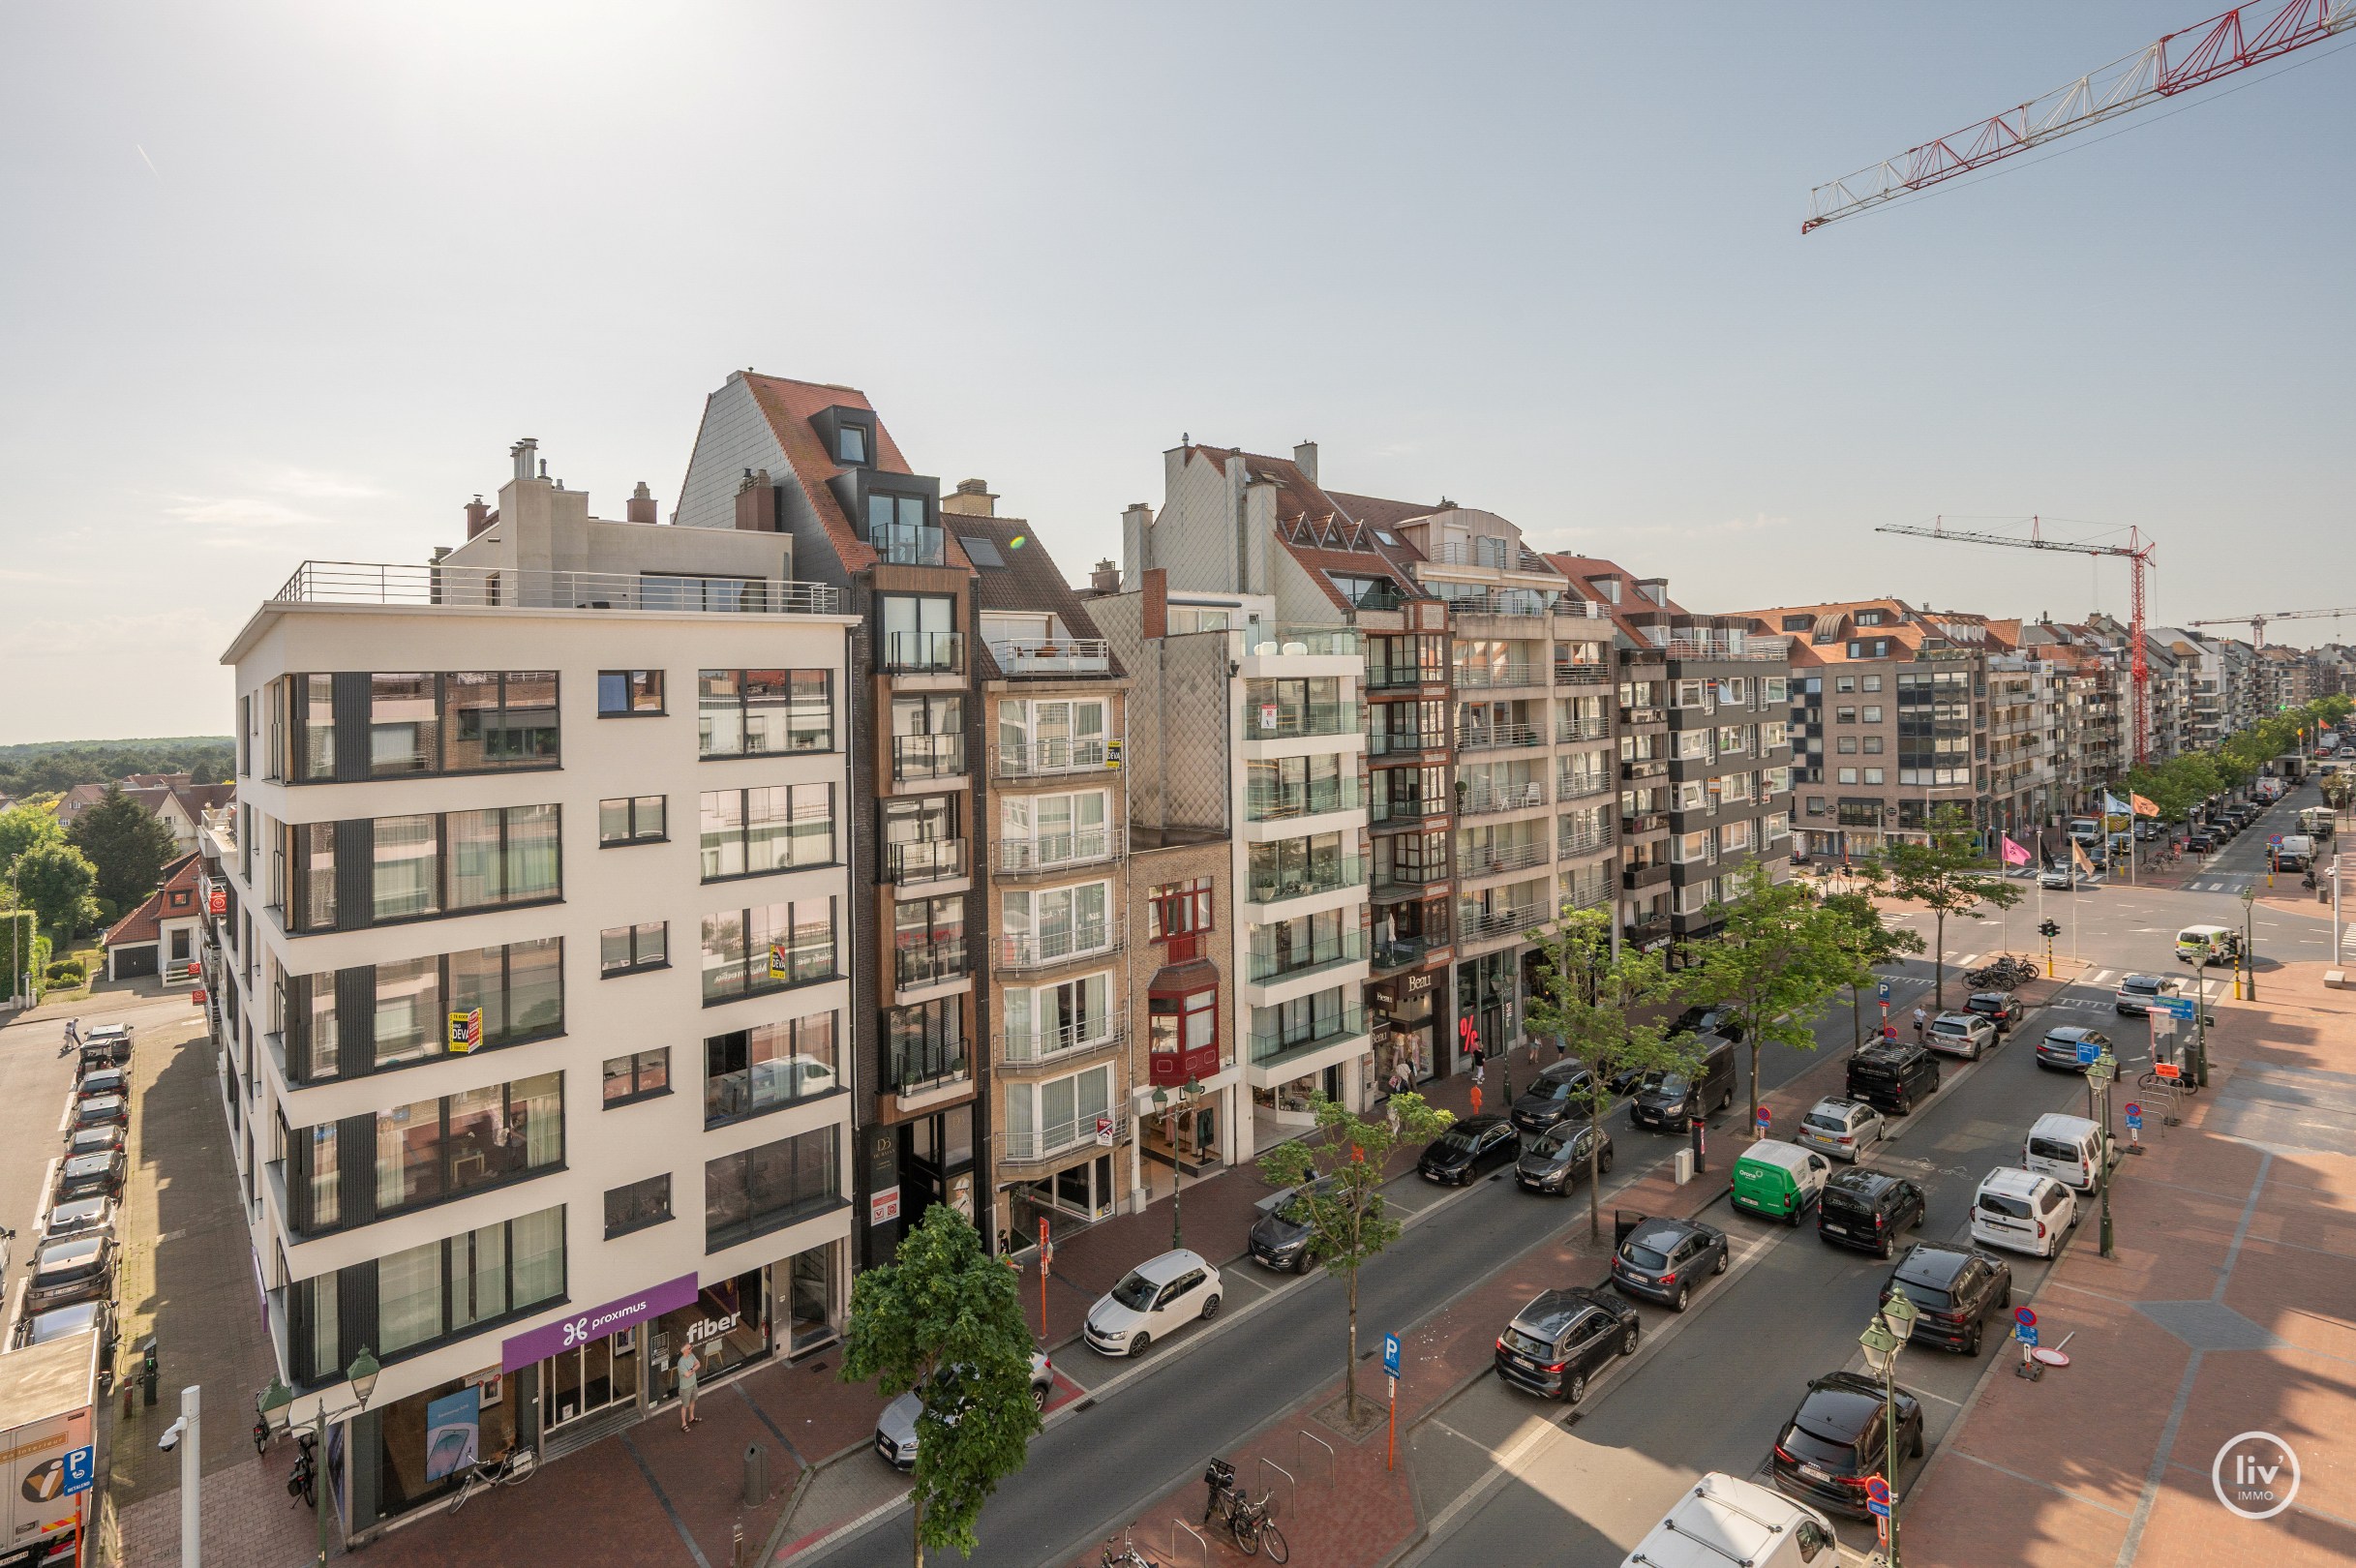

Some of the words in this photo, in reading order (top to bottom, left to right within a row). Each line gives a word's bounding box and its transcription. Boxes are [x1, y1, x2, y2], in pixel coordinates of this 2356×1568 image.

[1408, 975, 1432, 992] Beau
[1880, 984, 1888, 995] P
[1376, 992, 1393, 1004] Beau
[1372, 1031, 1387, 1045] Beau
[1739, 1169, 1757, 1179] Orona
[591, 1301, 647, 1331] proximus
[686, 1312, 741, 1343] fiber
[1385, 1338, 1398, 1360] P
[70, 1451, 87, 1471] P
